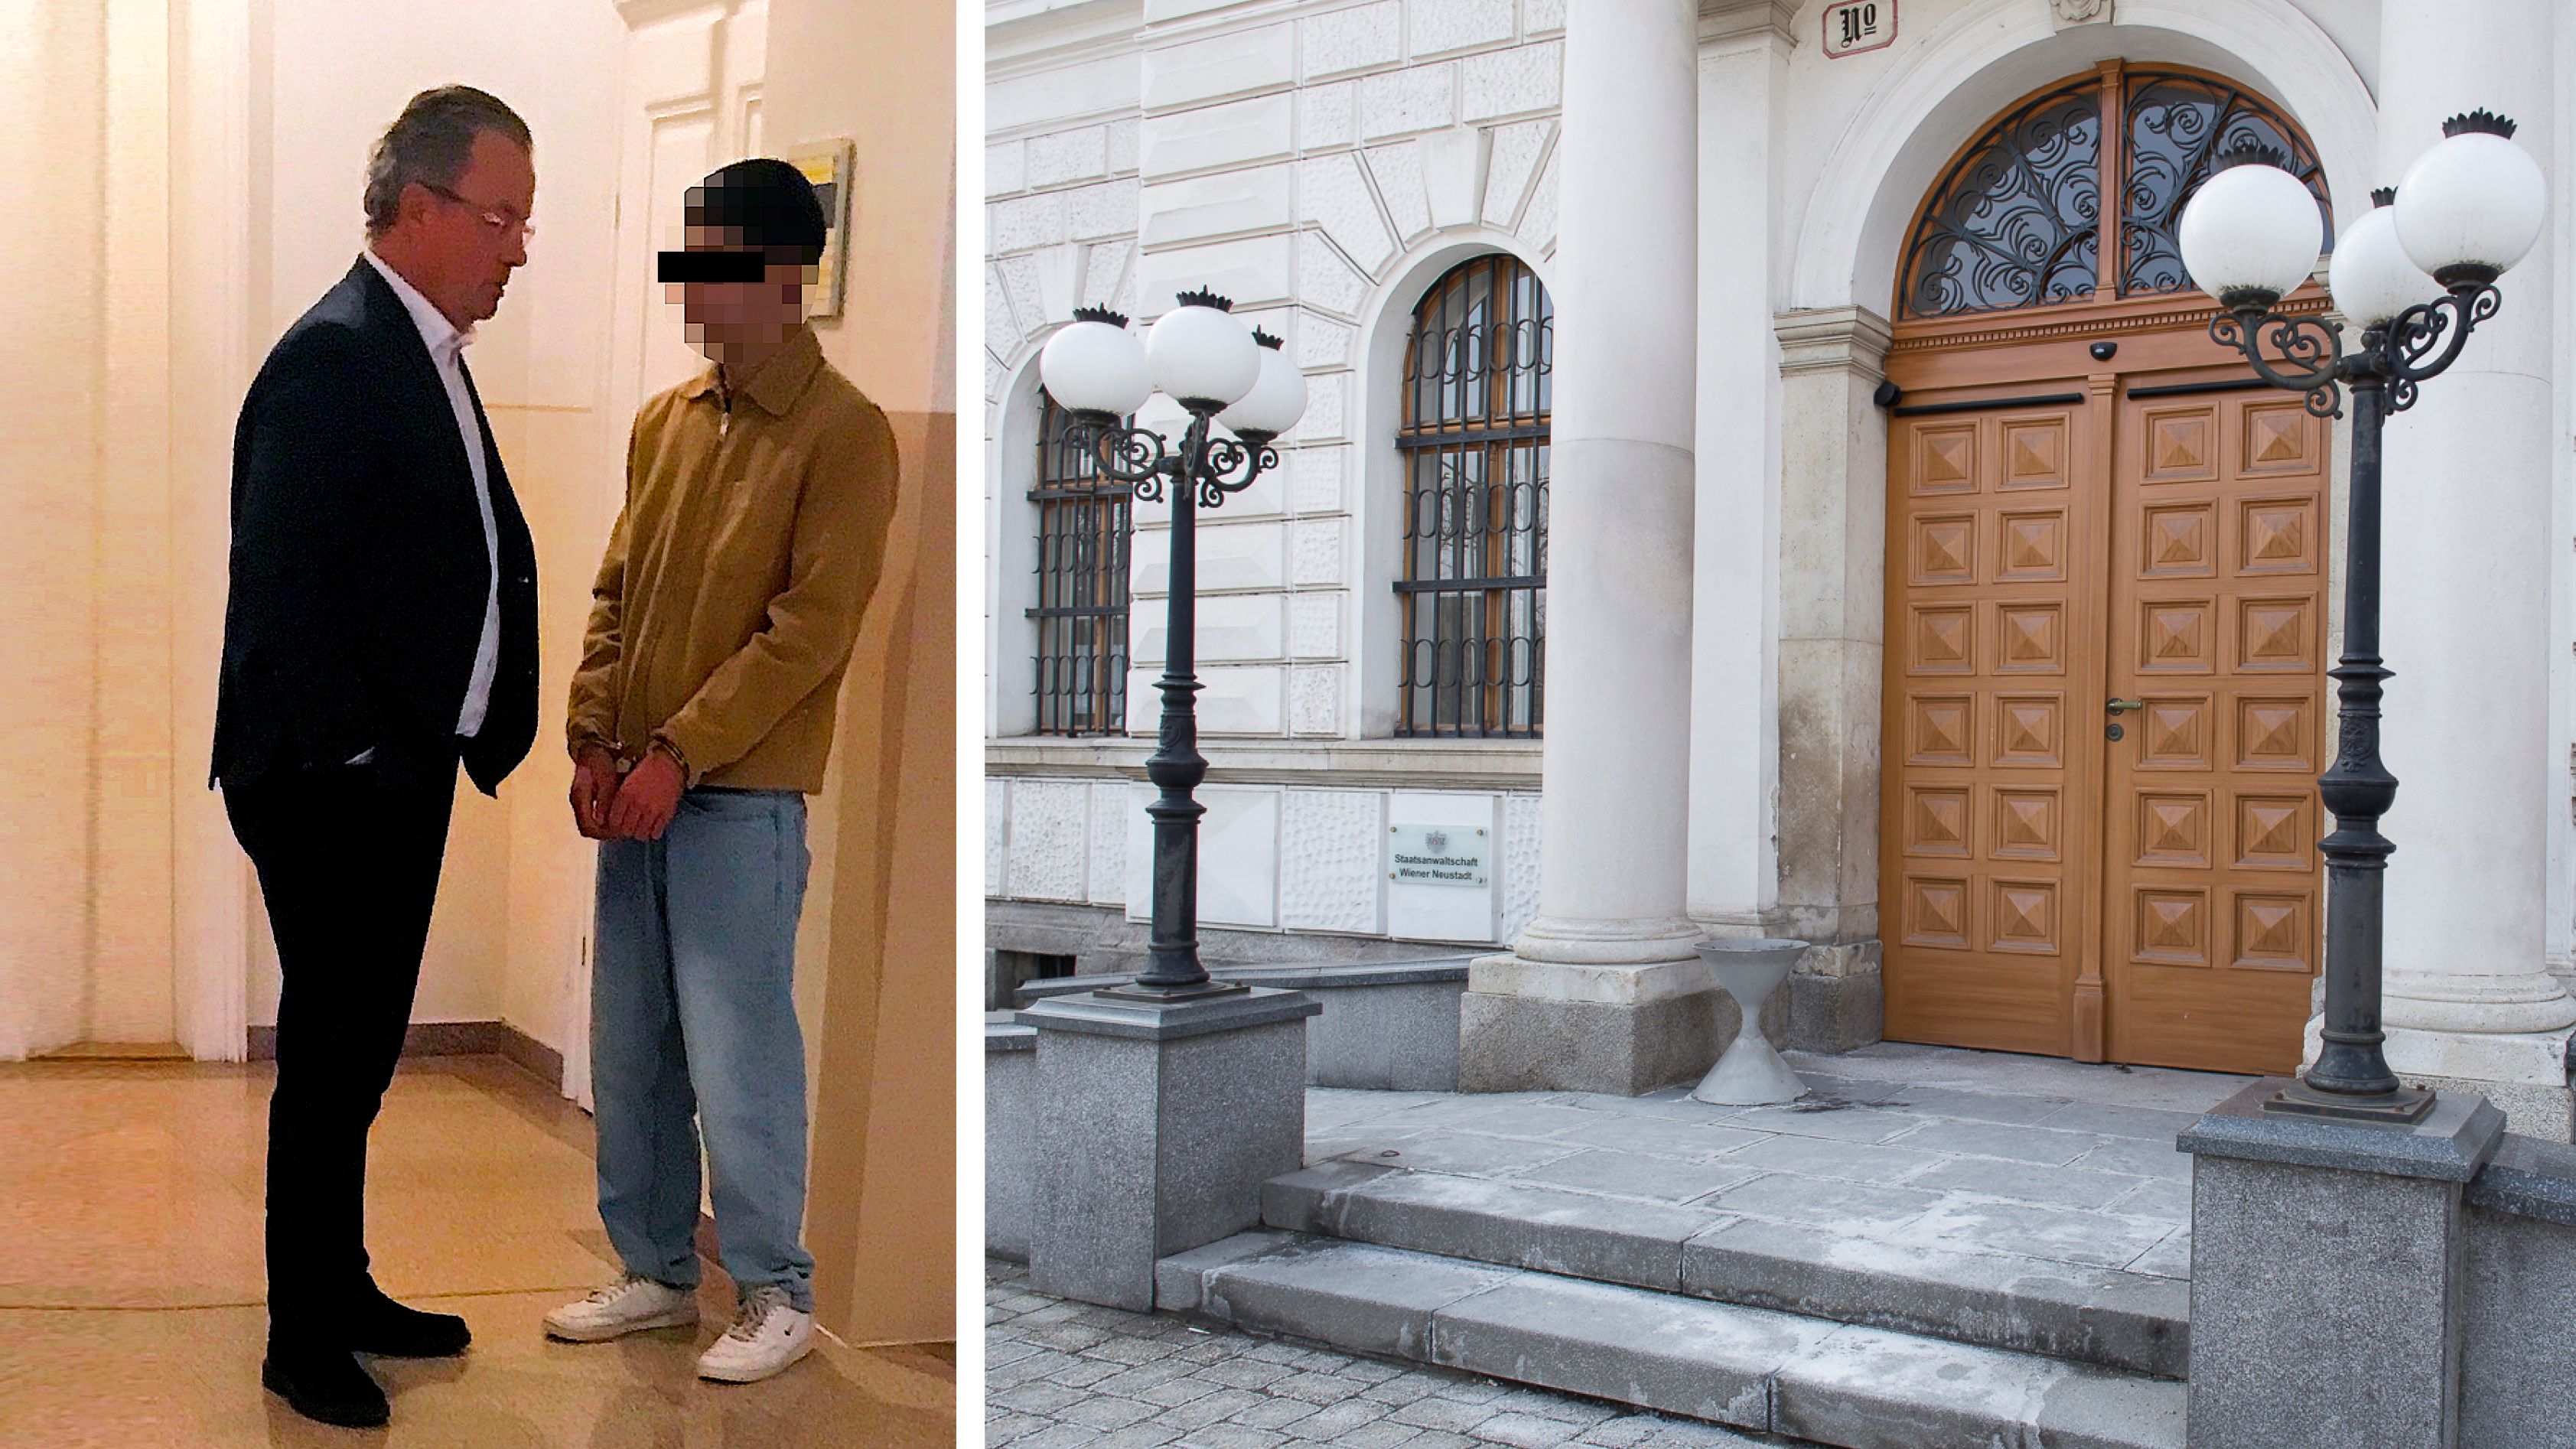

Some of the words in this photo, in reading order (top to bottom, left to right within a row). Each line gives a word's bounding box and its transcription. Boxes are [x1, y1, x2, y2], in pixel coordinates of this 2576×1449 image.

[1395, 854, 1477, 867] Staatsanwaltschaft
[1399, 868, 1429, 878] Wiener
[1431, 869, 1472, 881] Neustadt
